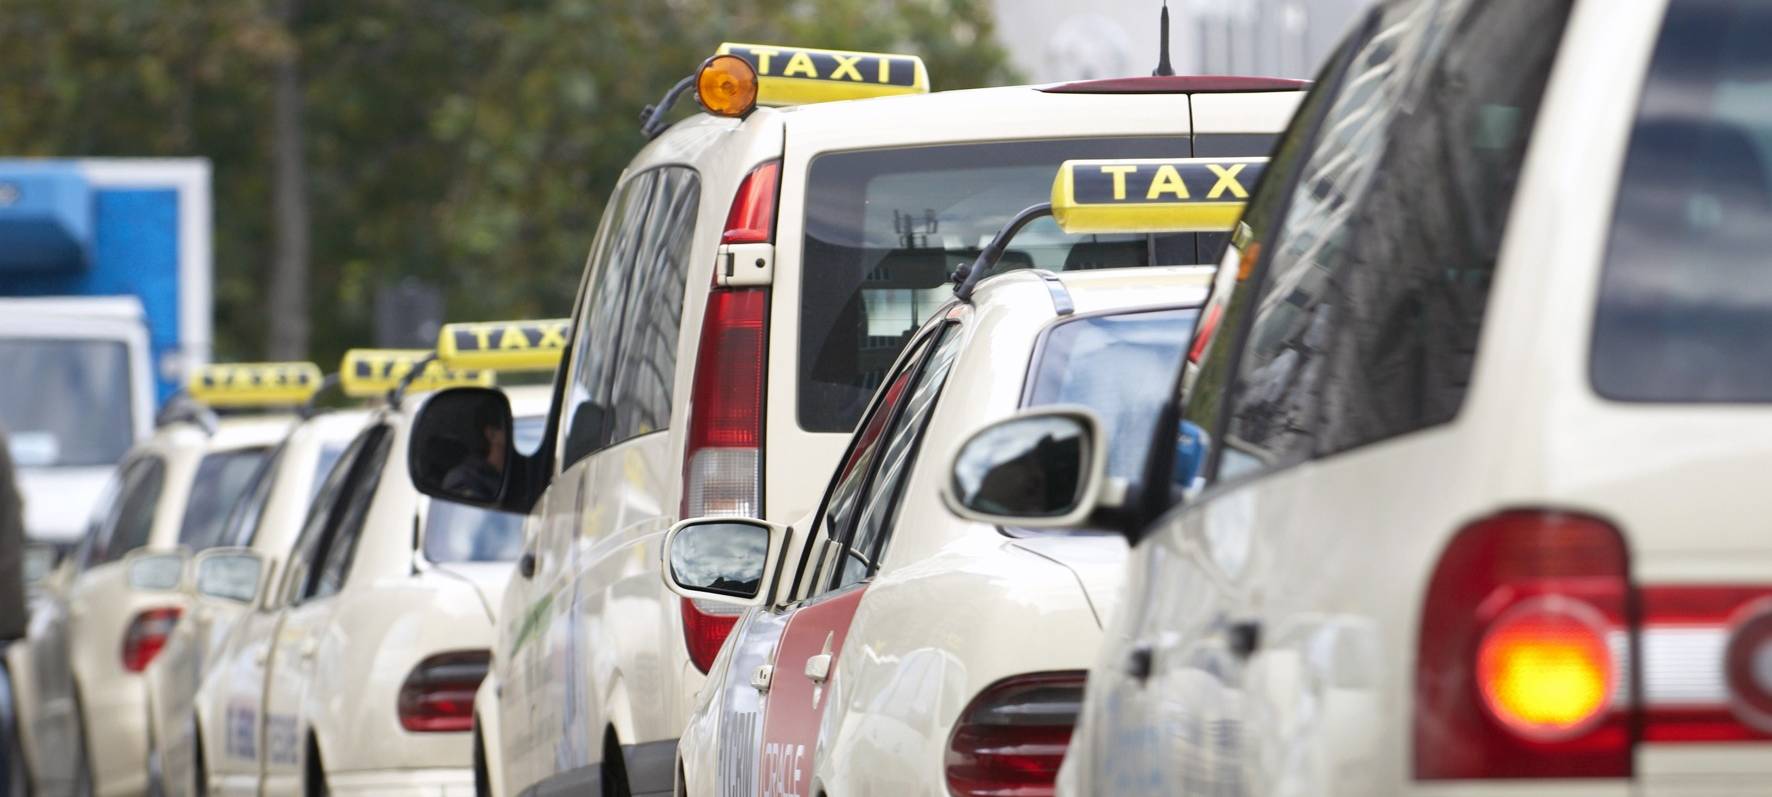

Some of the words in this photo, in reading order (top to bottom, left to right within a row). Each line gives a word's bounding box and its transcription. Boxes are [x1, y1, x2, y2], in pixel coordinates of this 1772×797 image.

[751, 50, 890, 84] TAXI
[1100, 163, 1250, 200] TAX
[467, 324, 568, 350] TAX
